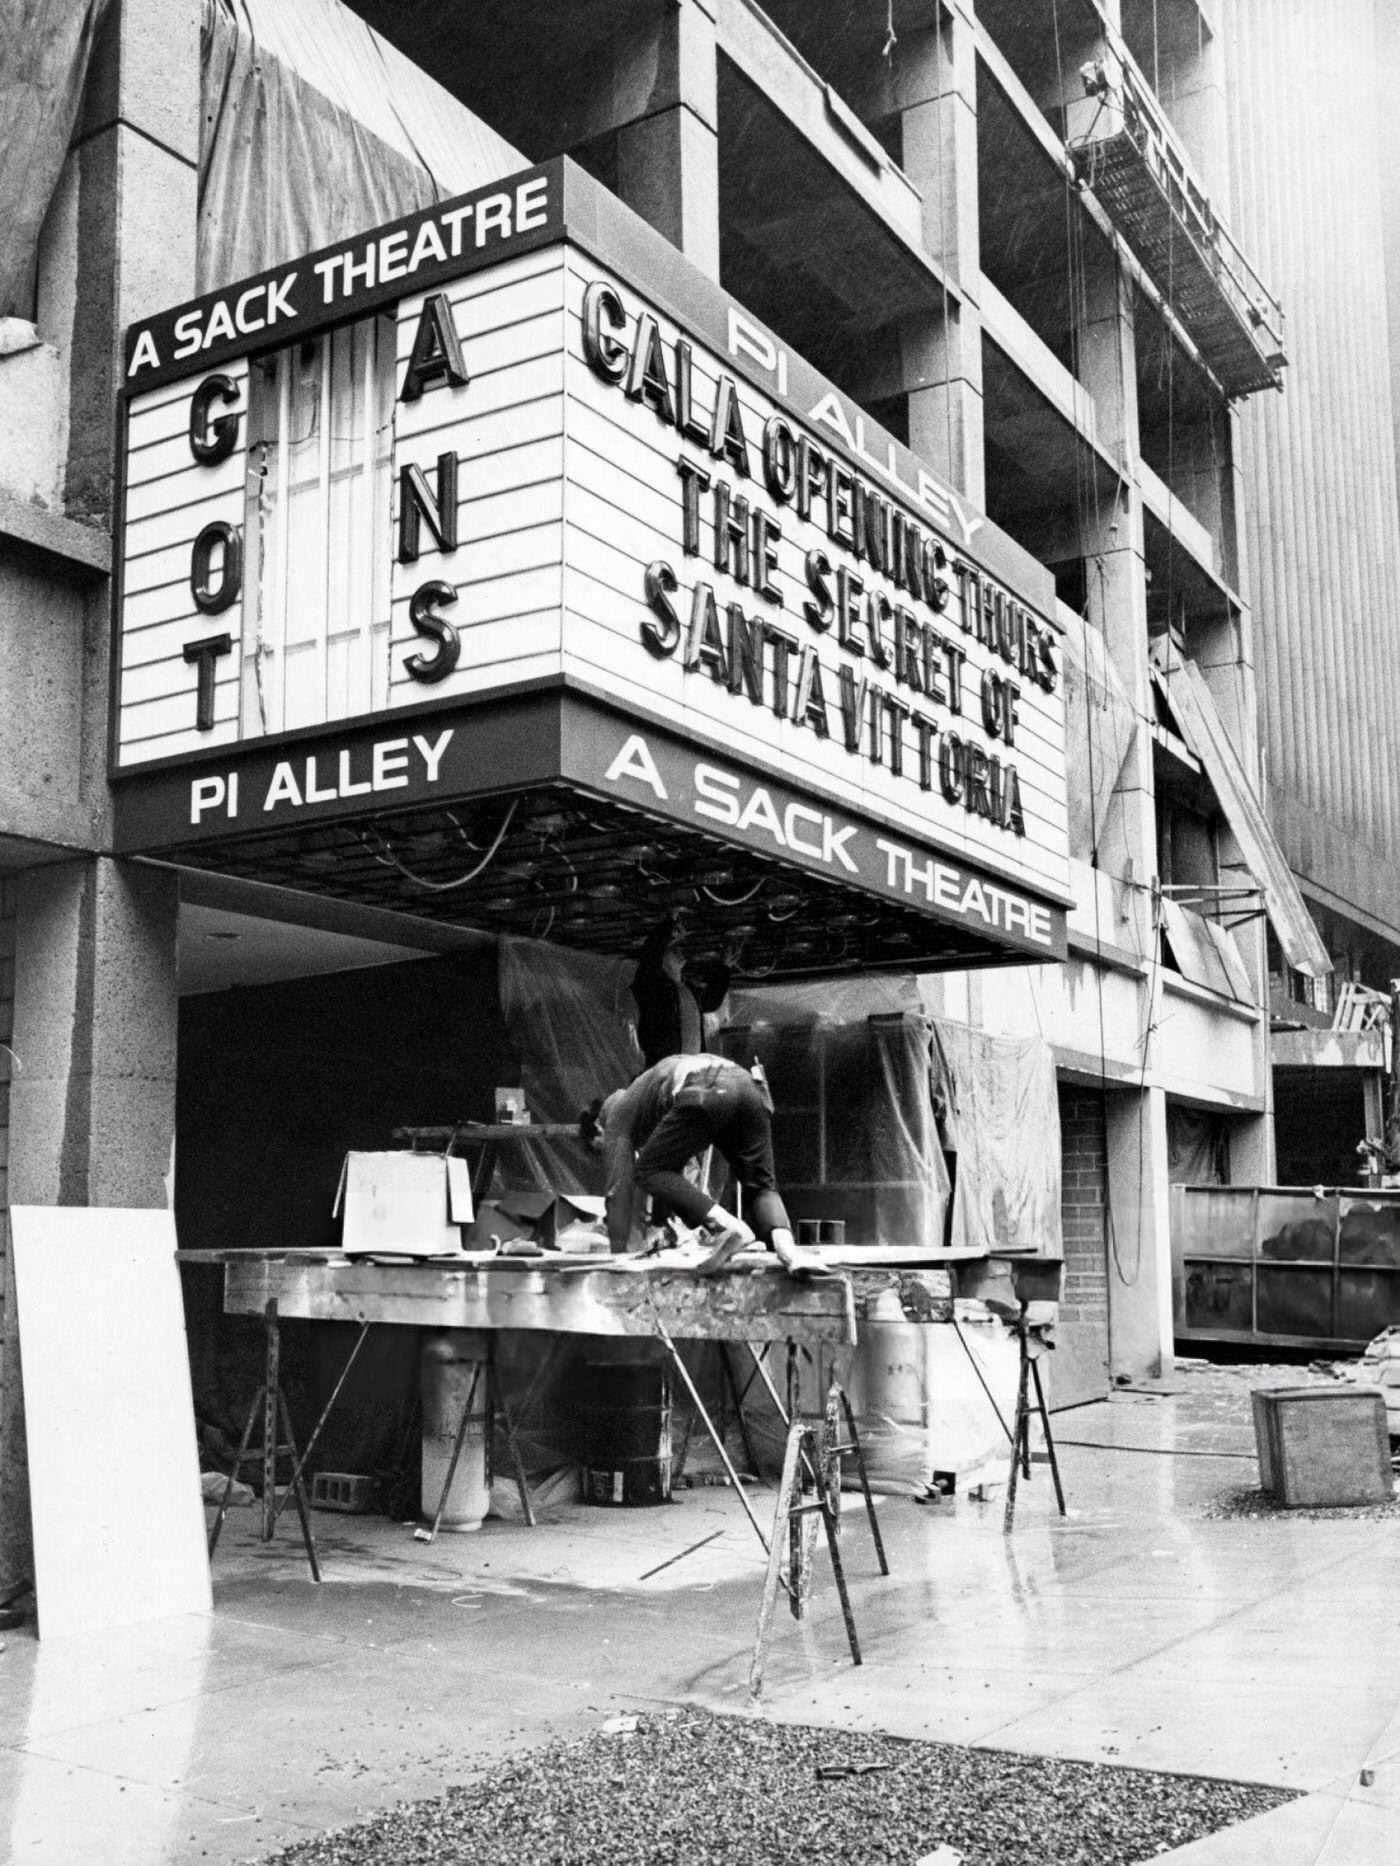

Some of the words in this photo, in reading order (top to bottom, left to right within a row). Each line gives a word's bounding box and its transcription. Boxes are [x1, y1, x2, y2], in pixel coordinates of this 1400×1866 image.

[127, 330, 160, 376] A
[172, 272, 299, 360] SACK
[313, 175, 549, 305] THEATRE
[581, 280, 750, 480] GALA
[762, 414, 950, 614] OPENING
[951, 556, 1059, 694] THURS
[727, 306, 788, 394] PI
[807, 392, 984, 546] ALLEY
[640, 559, 831, 741] SANTA
[840, 662, 1026, 837] VITTORIA
[676, 454, 783, 608] THE
[803, 548, 967, 717] SECRET
[981, 667, 1022, 748] OF
[190, 773, 238, 824] PI
[263, 729, 455, 812] ALLEY
[604, 734, 668, 800] A
[694, 762, 860, 874] SACK
[876, 839, 1053, 946] THEATRE
